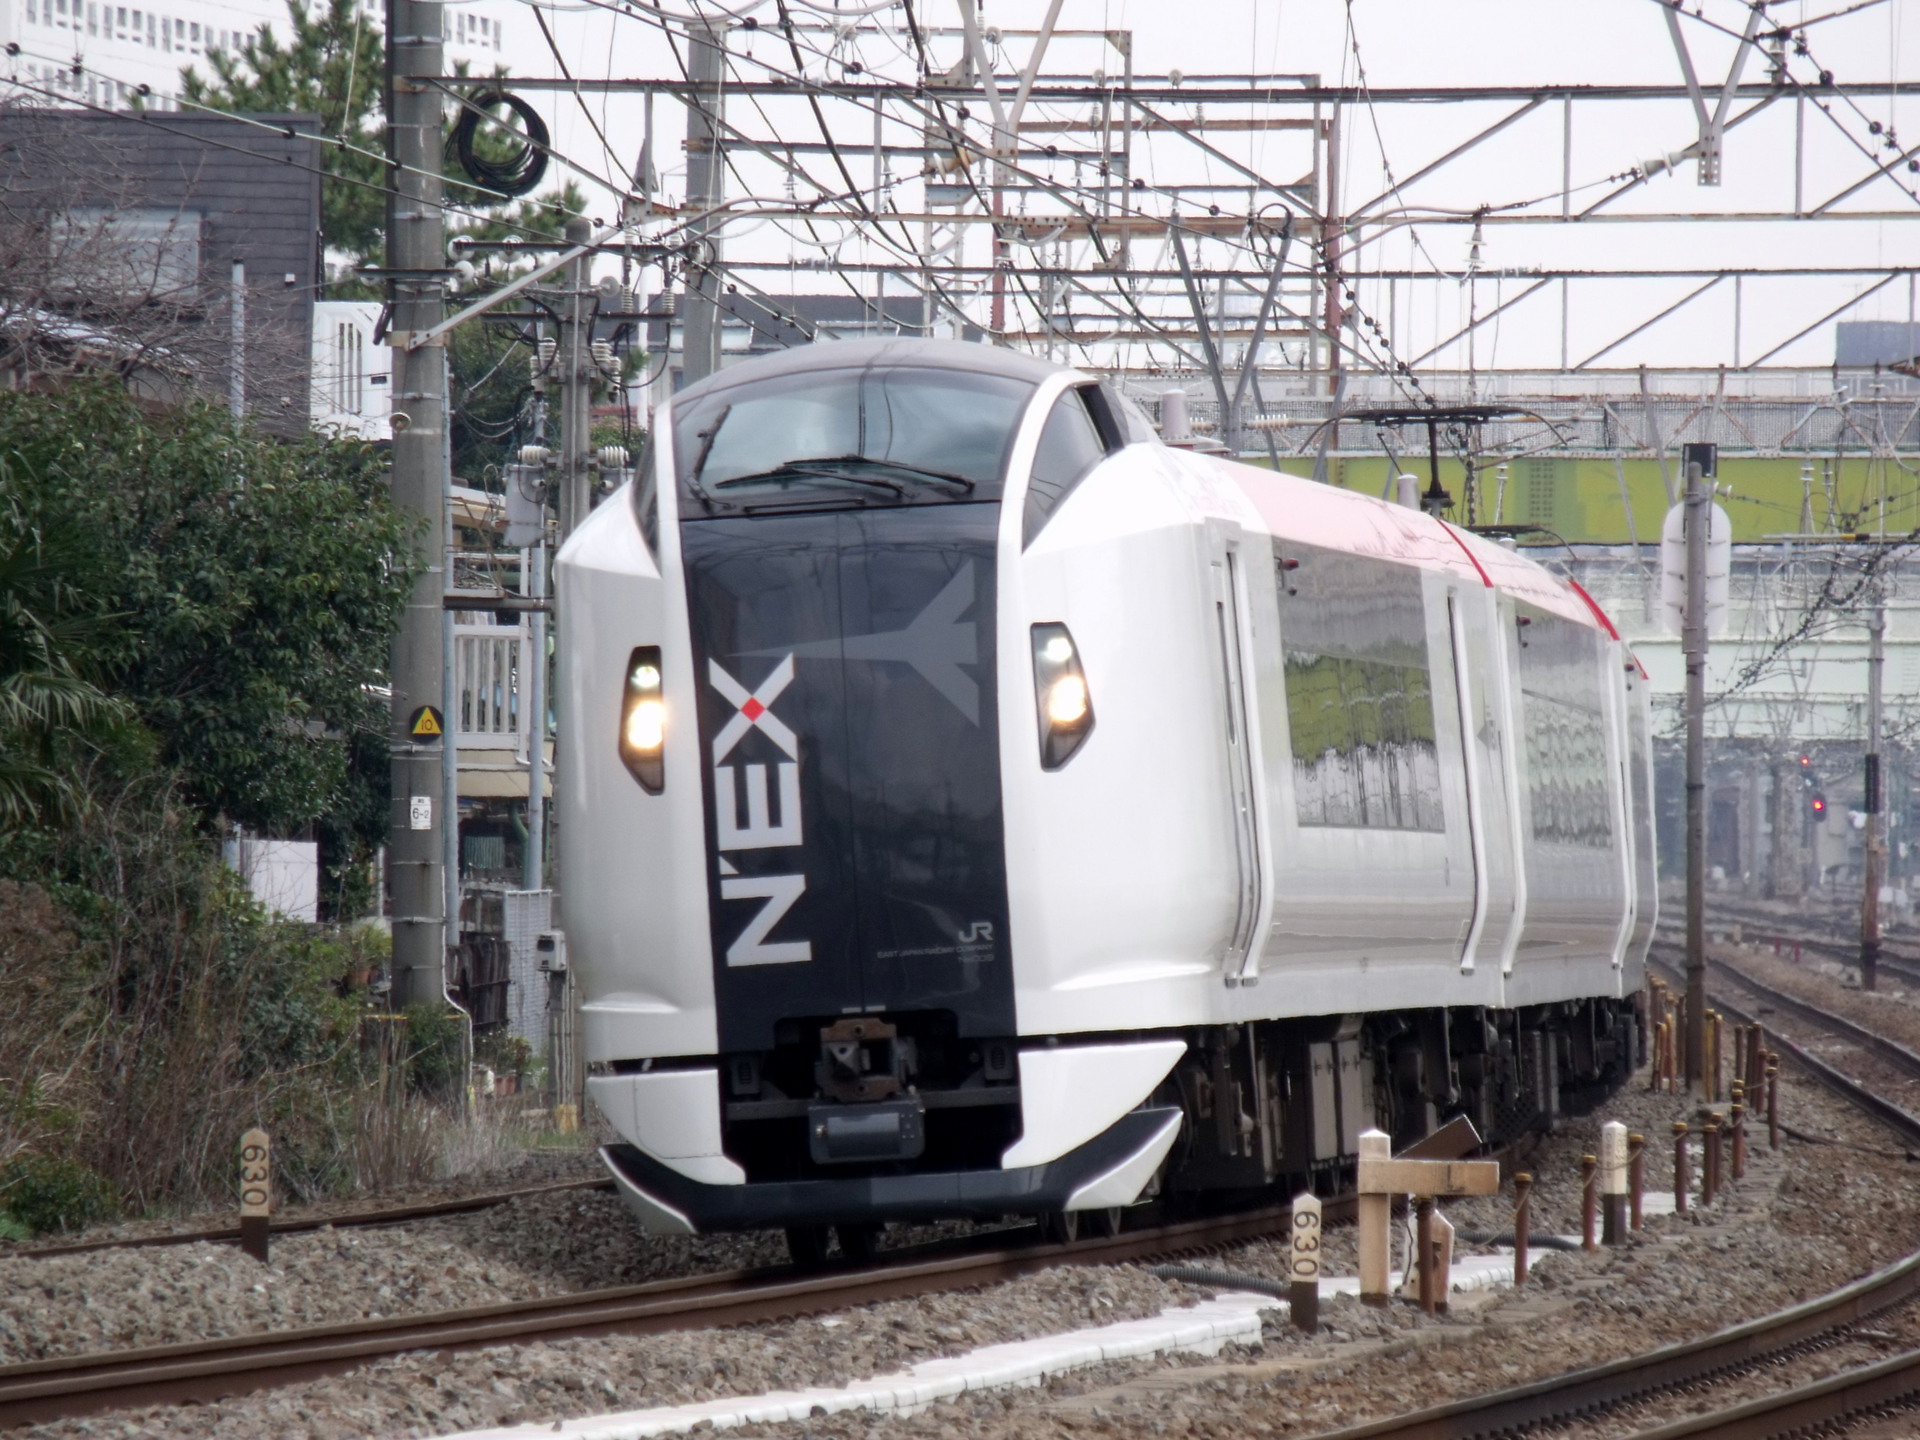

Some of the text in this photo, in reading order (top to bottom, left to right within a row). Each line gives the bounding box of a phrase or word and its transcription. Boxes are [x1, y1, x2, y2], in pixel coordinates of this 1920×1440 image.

[421, 719, 433, 731] 10
[412, 807, 429, 820] 6-2
[958, 921, 993, 943] JR
[877, 950, 898, 959] EAST
[956, 944, 994, 953] COMPANY
[242, 1145, 267, 1205] 630
[1293, 1211, 1319, 1276] 630
